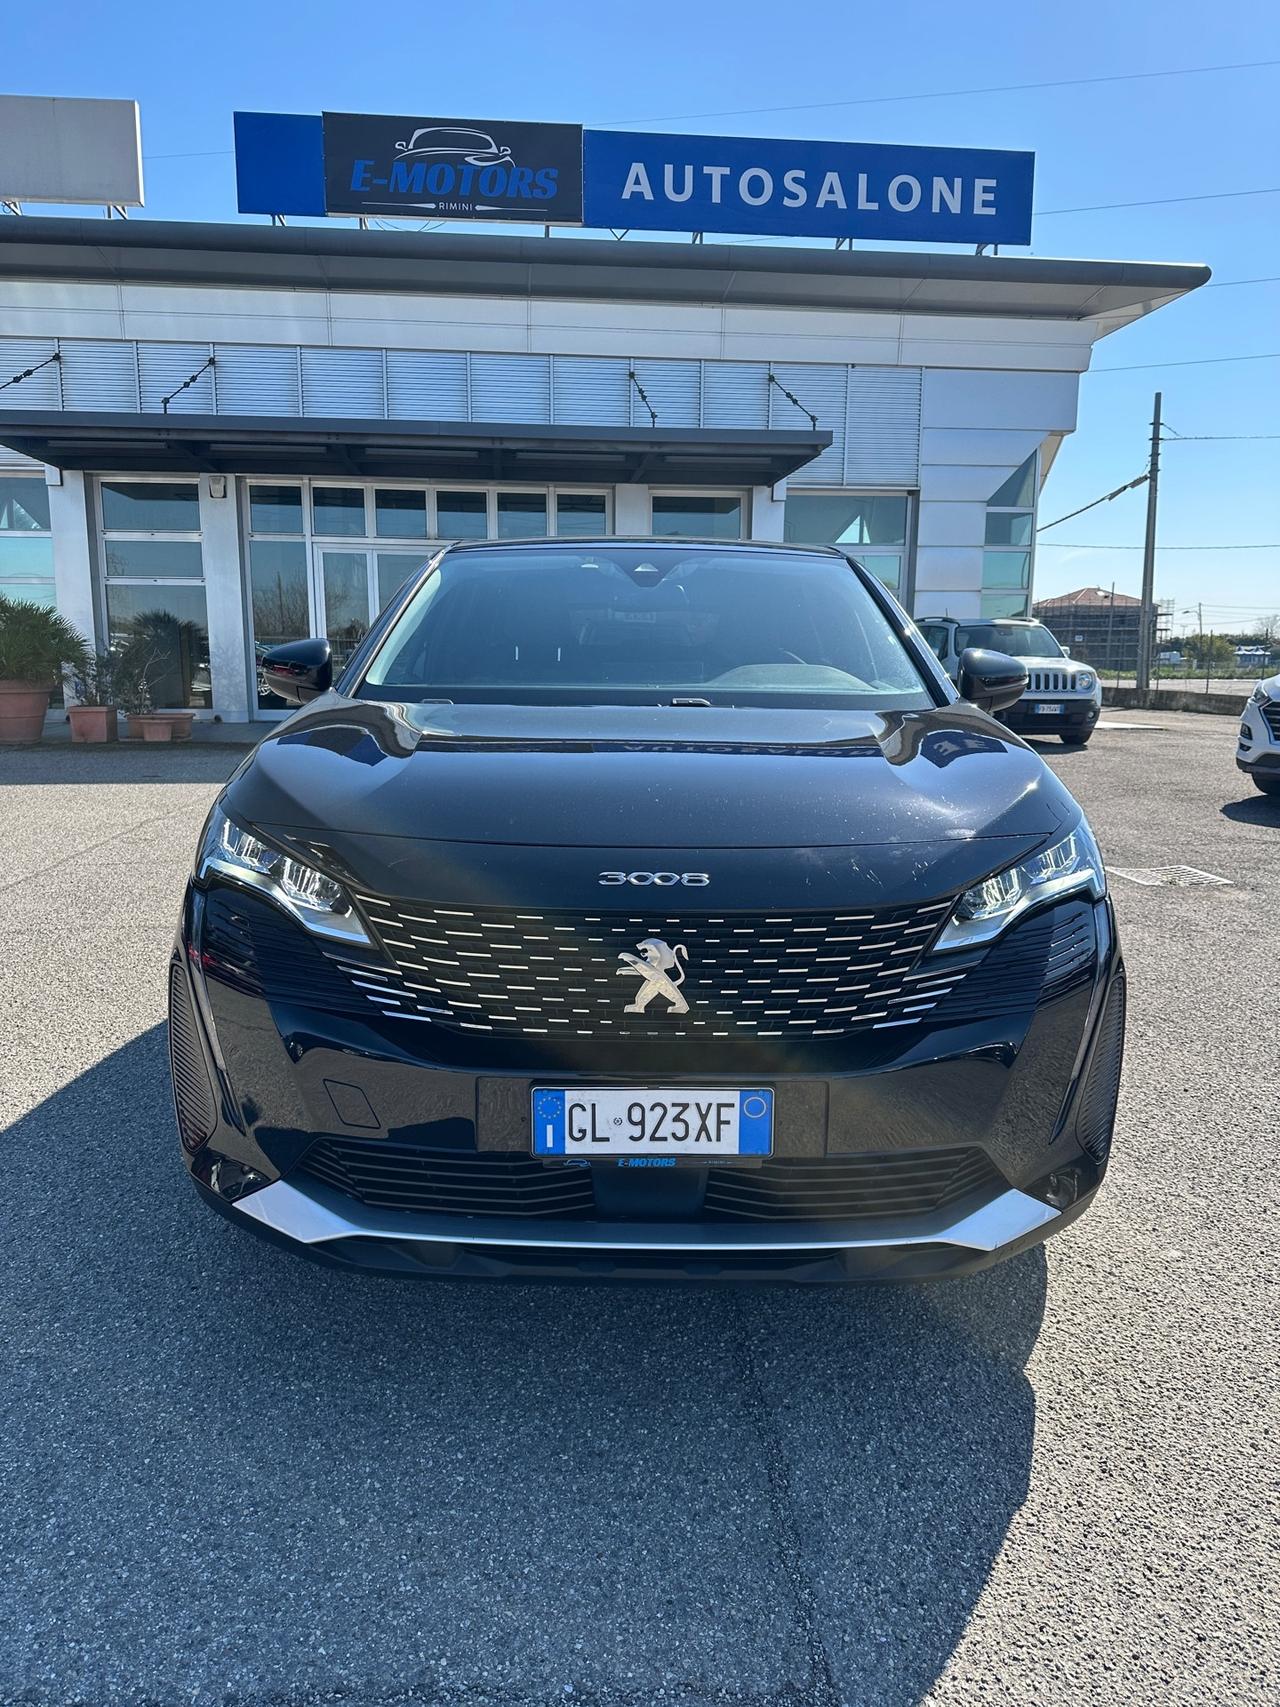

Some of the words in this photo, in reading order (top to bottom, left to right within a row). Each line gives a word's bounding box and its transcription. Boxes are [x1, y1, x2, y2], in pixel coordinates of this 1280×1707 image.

[350, 159, 559, 200] E-MOTORS
[621, 162, 998, 215] AUTOSALONE
[438, 202, 473, 211] RIMINI
[598, 871, 710, 887] 3008
[568, 1102, 610, 1142] GL
[627, 1102, 736, 1142] 923XF
[546, 1124, 554, 1147] I
[618, 1157, 677, 1167] E-MOTORS
